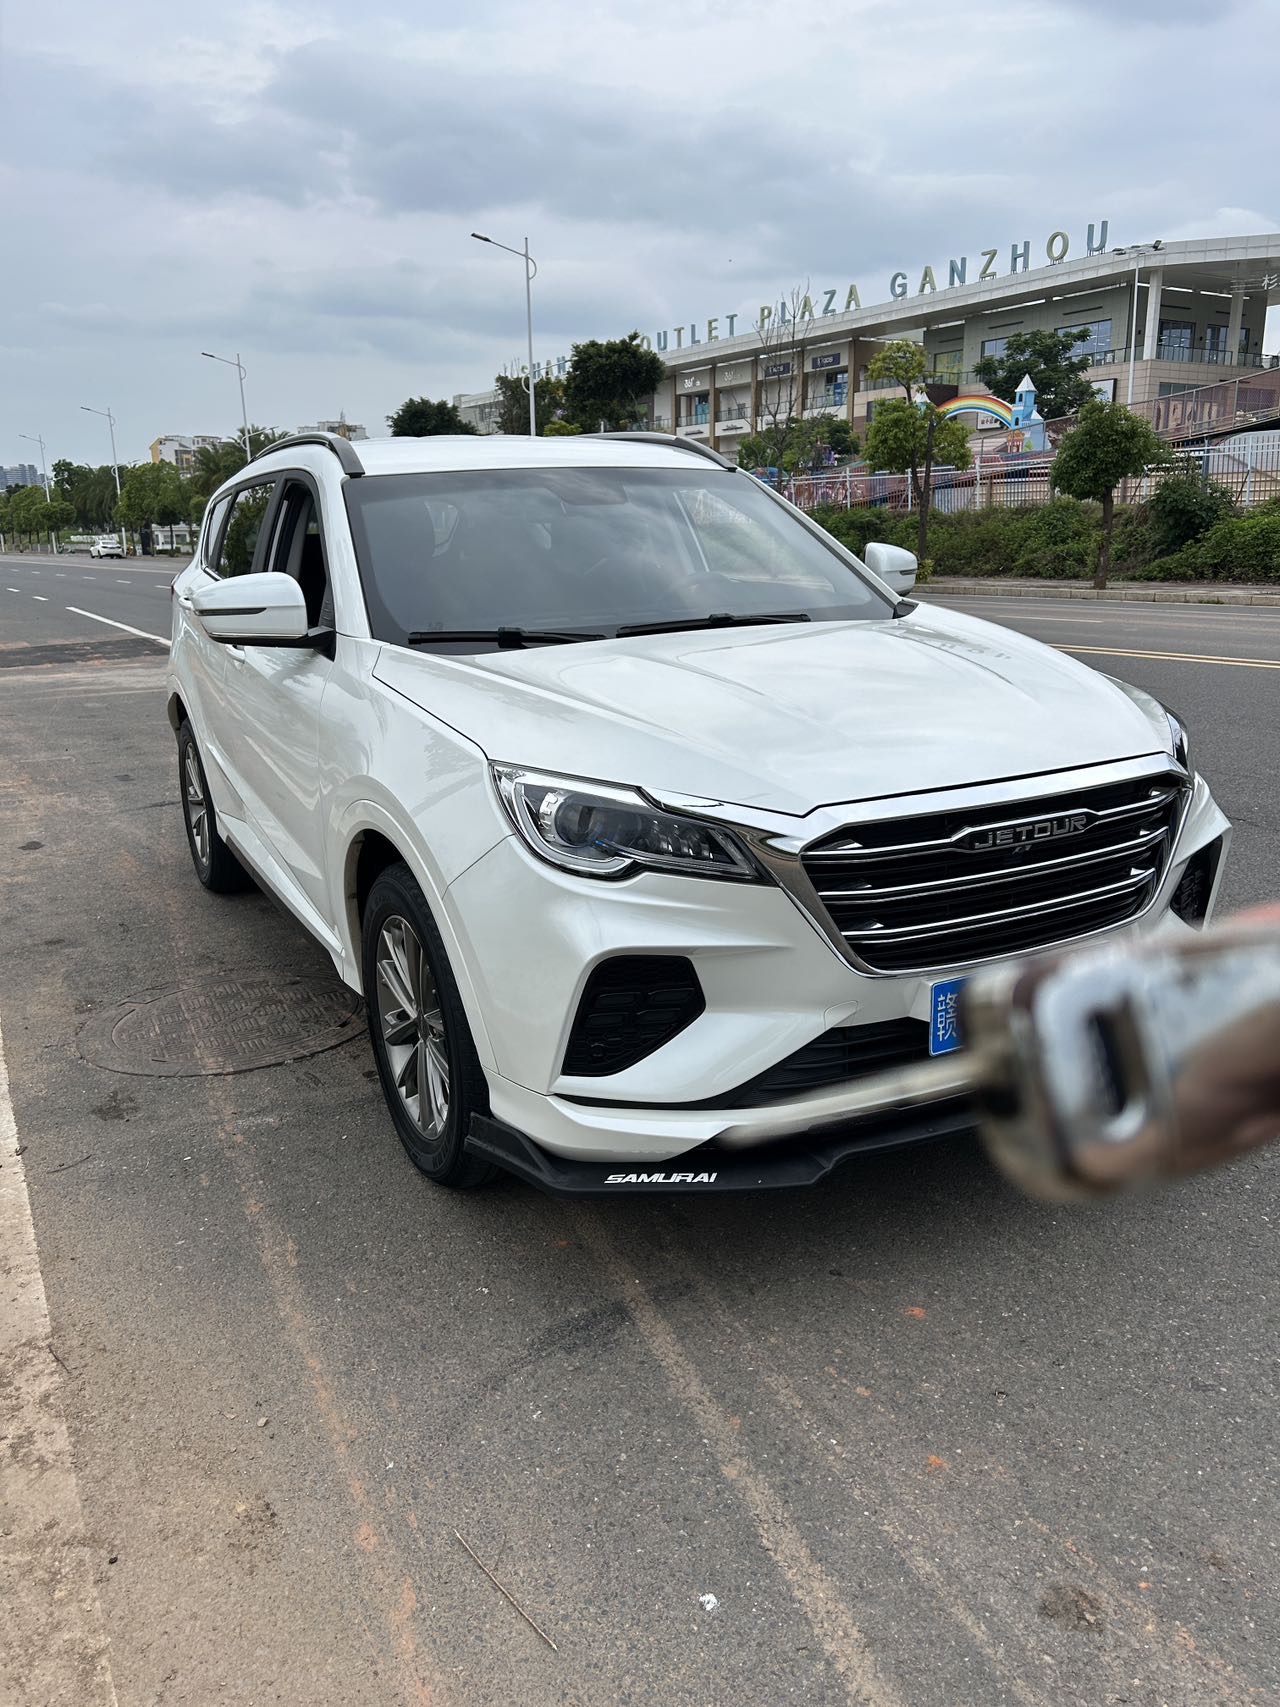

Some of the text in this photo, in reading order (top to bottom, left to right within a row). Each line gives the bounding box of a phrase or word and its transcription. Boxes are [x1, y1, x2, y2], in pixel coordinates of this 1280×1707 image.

[640, 314, 738, 352] OUTLET
[760, 284, 861, 330] PLAZA
[889, 220, 1109, 298] GANZHOU
[1261, 273, 1280, 291] 杉
[974, 815, 1087, 849] JETOUR
[604, 1172, 718, 1184] SAMURAI
